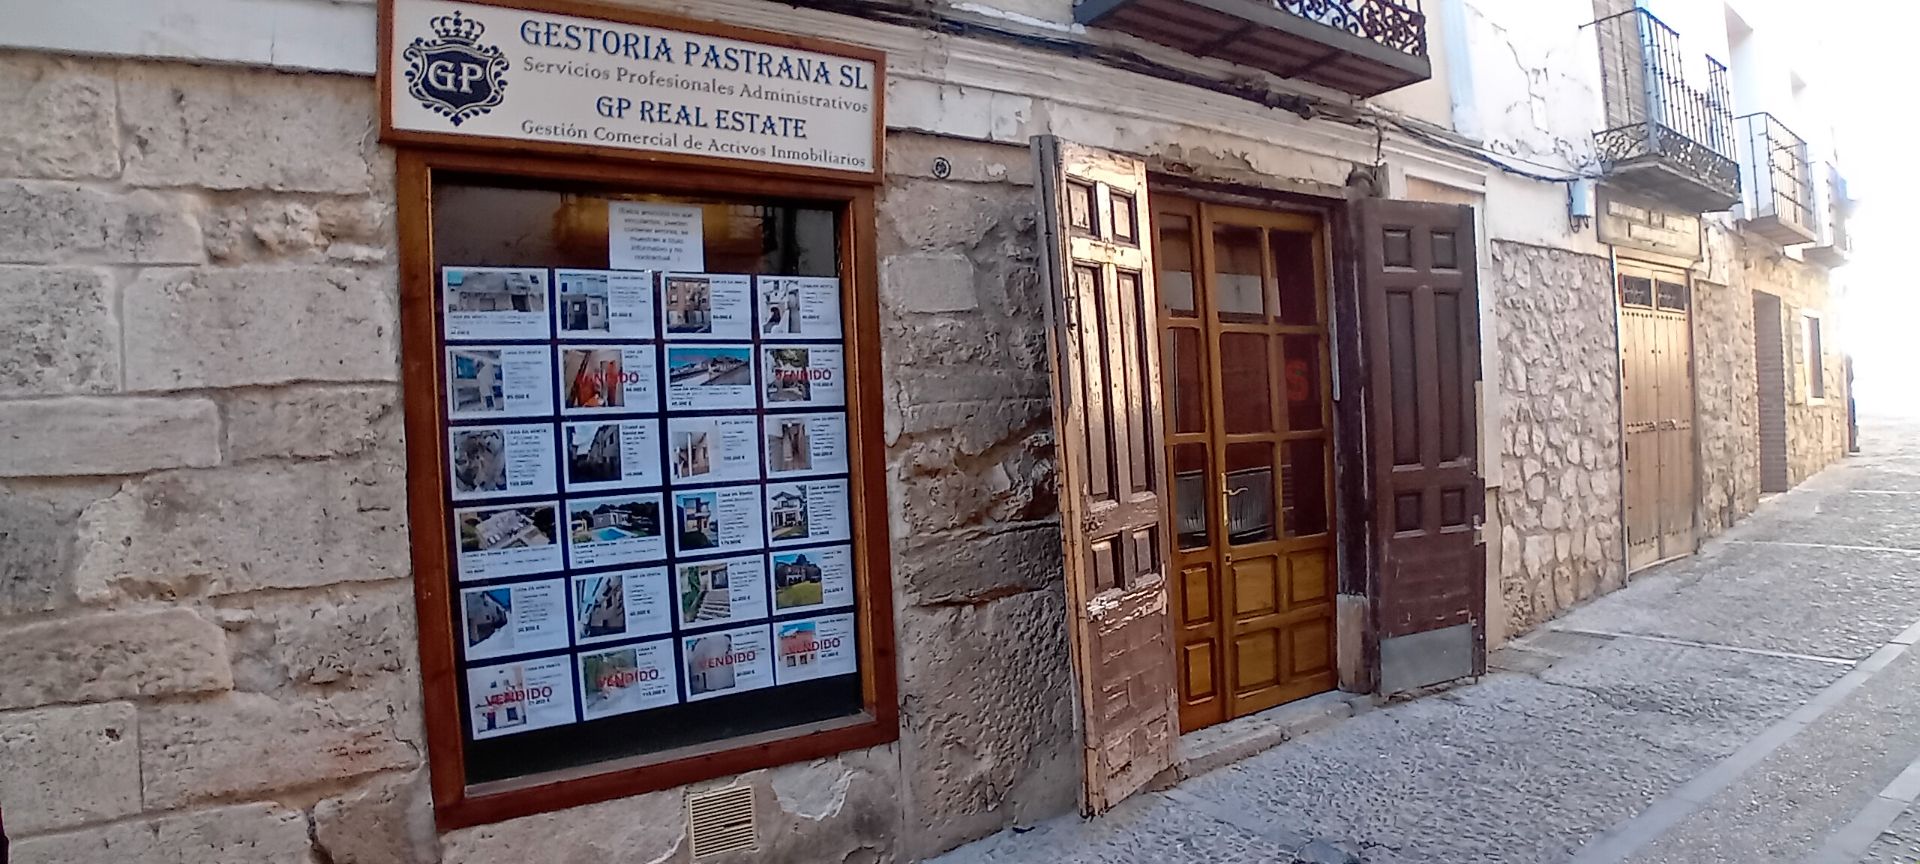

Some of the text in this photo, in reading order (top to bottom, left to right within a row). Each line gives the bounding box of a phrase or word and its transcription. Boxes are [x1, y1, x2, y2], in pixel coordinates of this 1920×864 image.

[428, 60, 486, 94] GP
[520, 19, 868, 91] GESTORIA PASTRANA SL
[523, 56, 868, 113] Servicios Profesionales Administrativos
[596, 96, 807, 139] GP REAL ESTATE
[521, 119, 866, 167] Gestión Comercial de Activos Inmobiliarios
